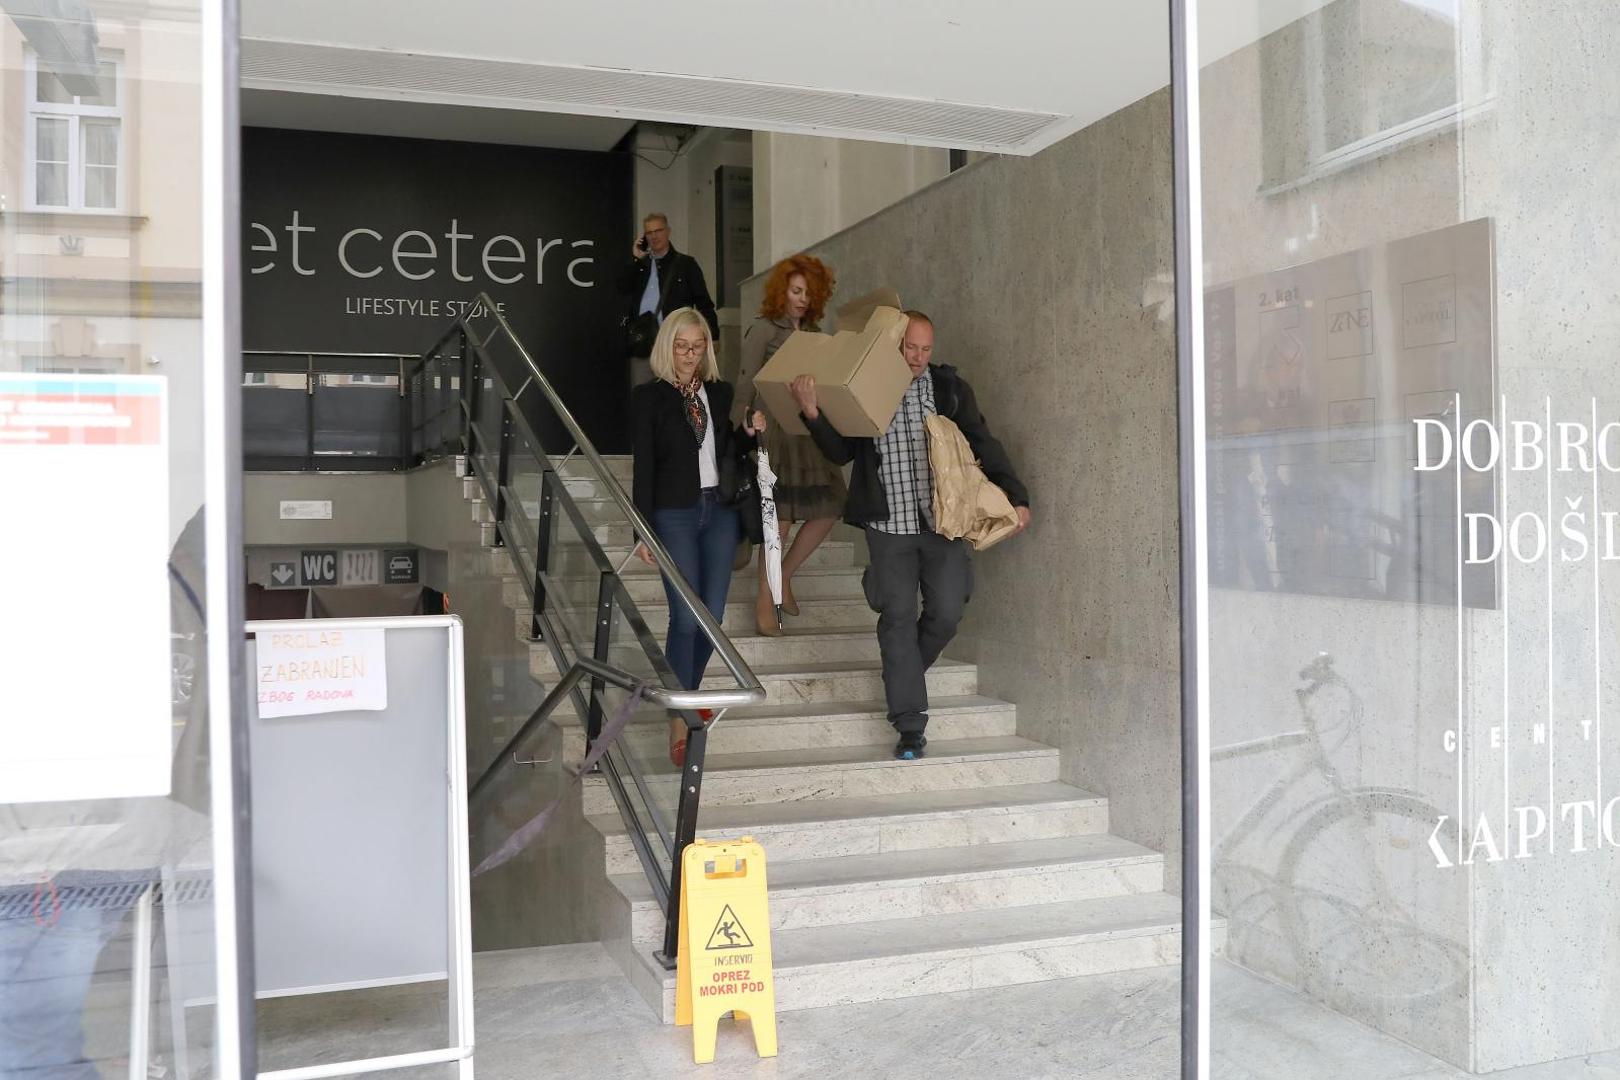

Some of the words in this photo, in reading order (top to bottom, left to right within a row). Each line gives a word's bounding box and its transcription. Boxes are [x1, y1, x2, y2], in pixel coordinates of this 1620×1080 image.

[338, 218, 595, 288] cetera
[346, 297, 439, 316] LIFESTYLE
[1413, 419, 1620, 472] DOBRO
[303, 554, 335, 581] WC
[271, 632, 343, 649] PROLAZ
[712, 970, 750, 983] OPREZ
[700, 984, 738, 997] MOKRI
[741, 981, 765, 993] POD
